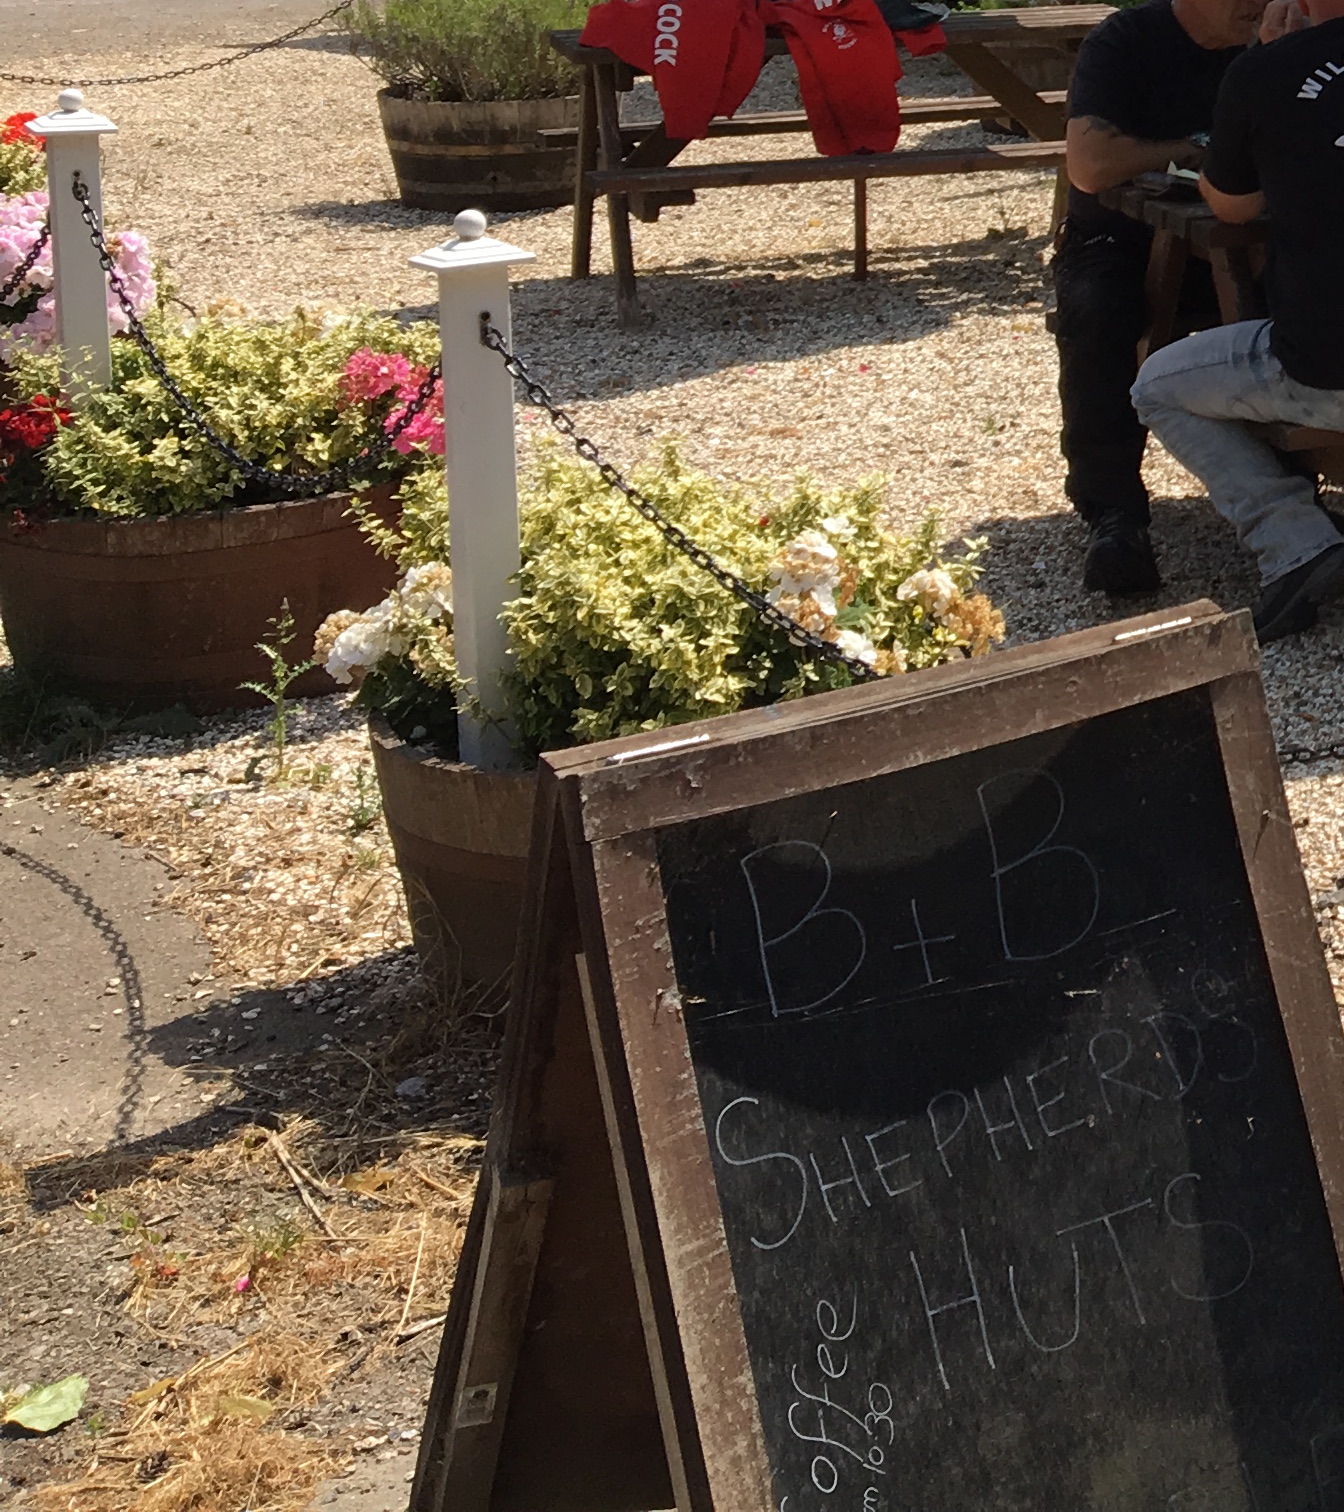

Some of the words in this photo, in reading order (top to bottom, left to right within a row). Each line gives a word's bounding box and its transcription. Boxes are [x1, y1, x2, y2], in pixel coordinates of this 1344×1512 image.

[654, 3, 682, 66] COCK
[716, 968, 1260, 1249] SHEPHERDS
[910, 1174, 1253, 1391] HUTS
[781, 1281, 873, 1512] offee
